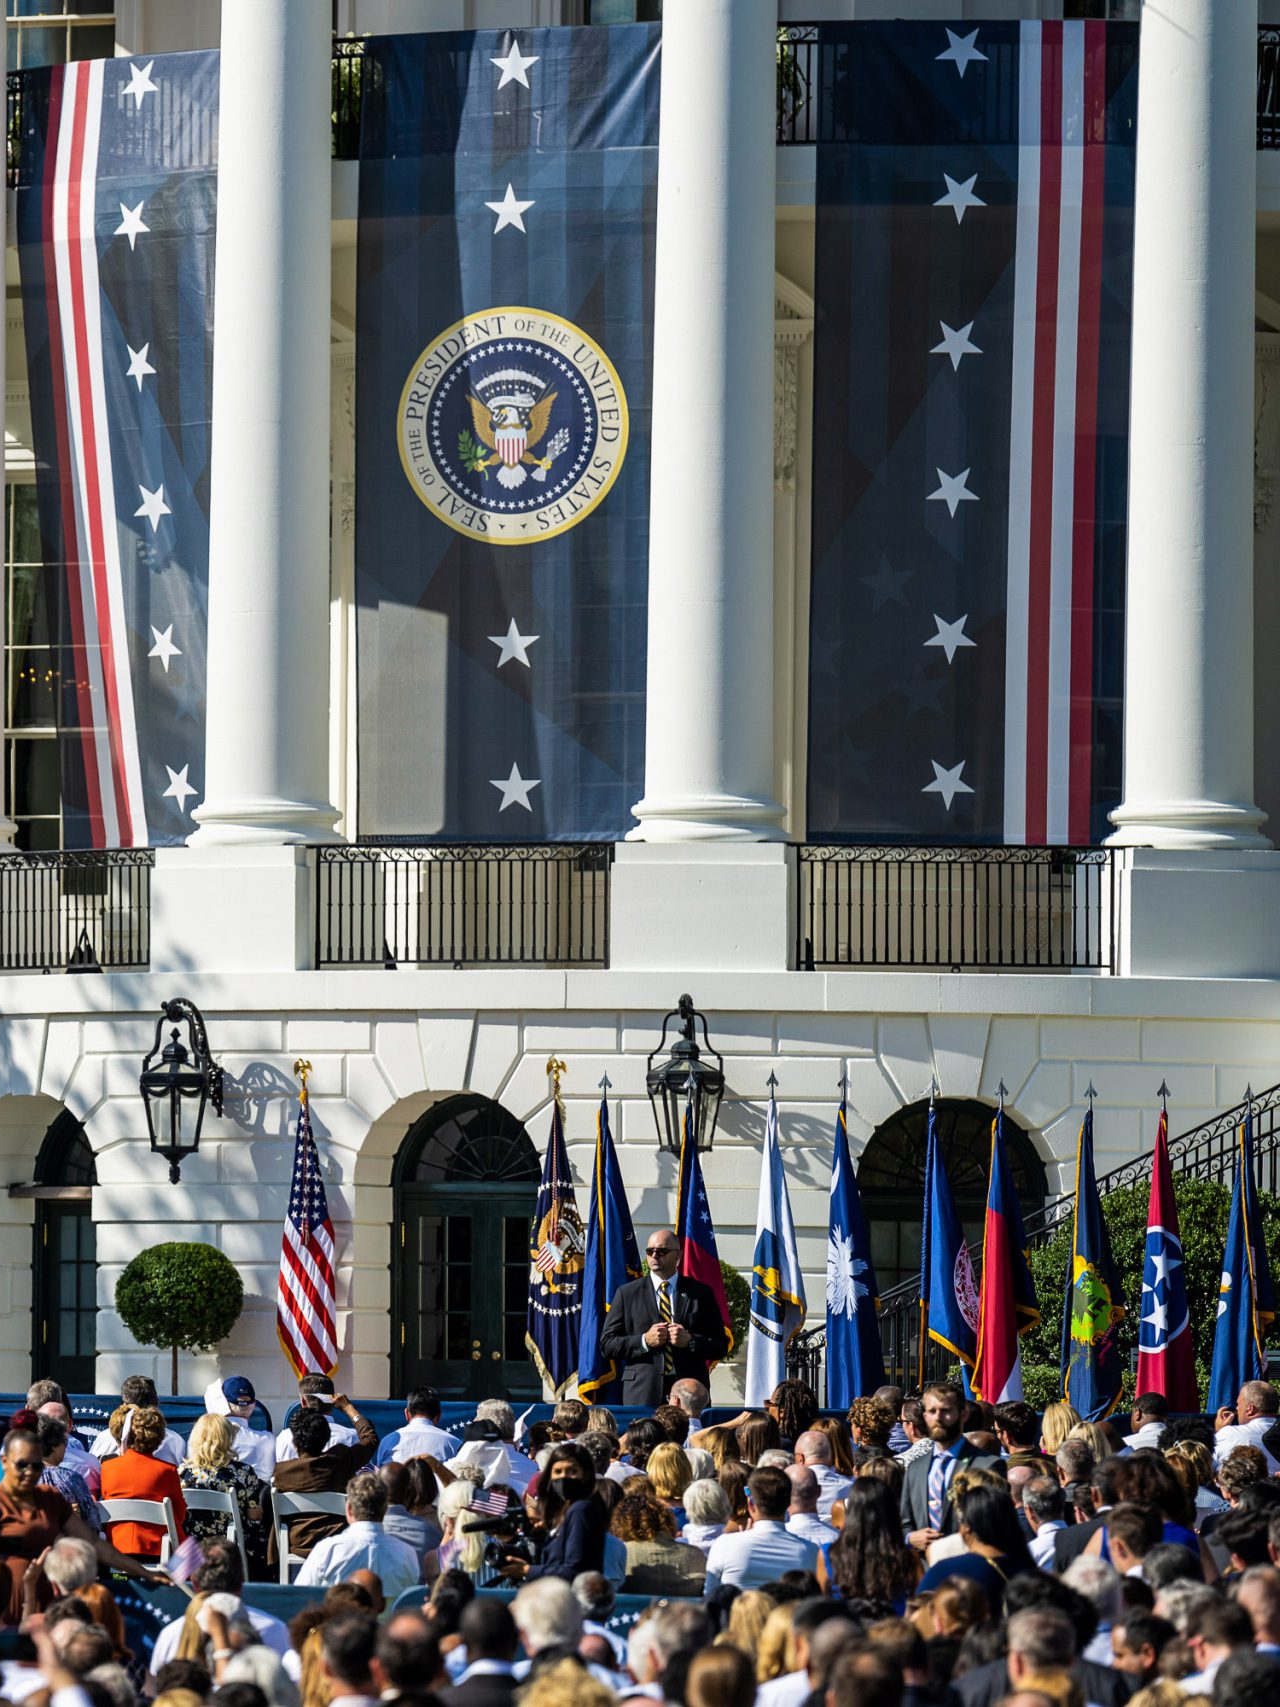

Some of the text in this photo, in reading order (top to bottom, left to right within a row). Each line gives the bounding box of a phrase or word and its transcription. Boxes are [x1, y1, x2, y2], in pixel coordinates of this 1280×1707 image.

[514, 319, 535, 332] OF
[540, 324, 571, 348] THE
[406, 316, 506, 421] PRESIDENT
[573, 344, 620, 443] UNITED
[408, 428, 424, 463] THE
[417, 465, 435, 486] OF
[536, 456, 612, 530] STATES
[440, 487, 491, 532] SEAL
